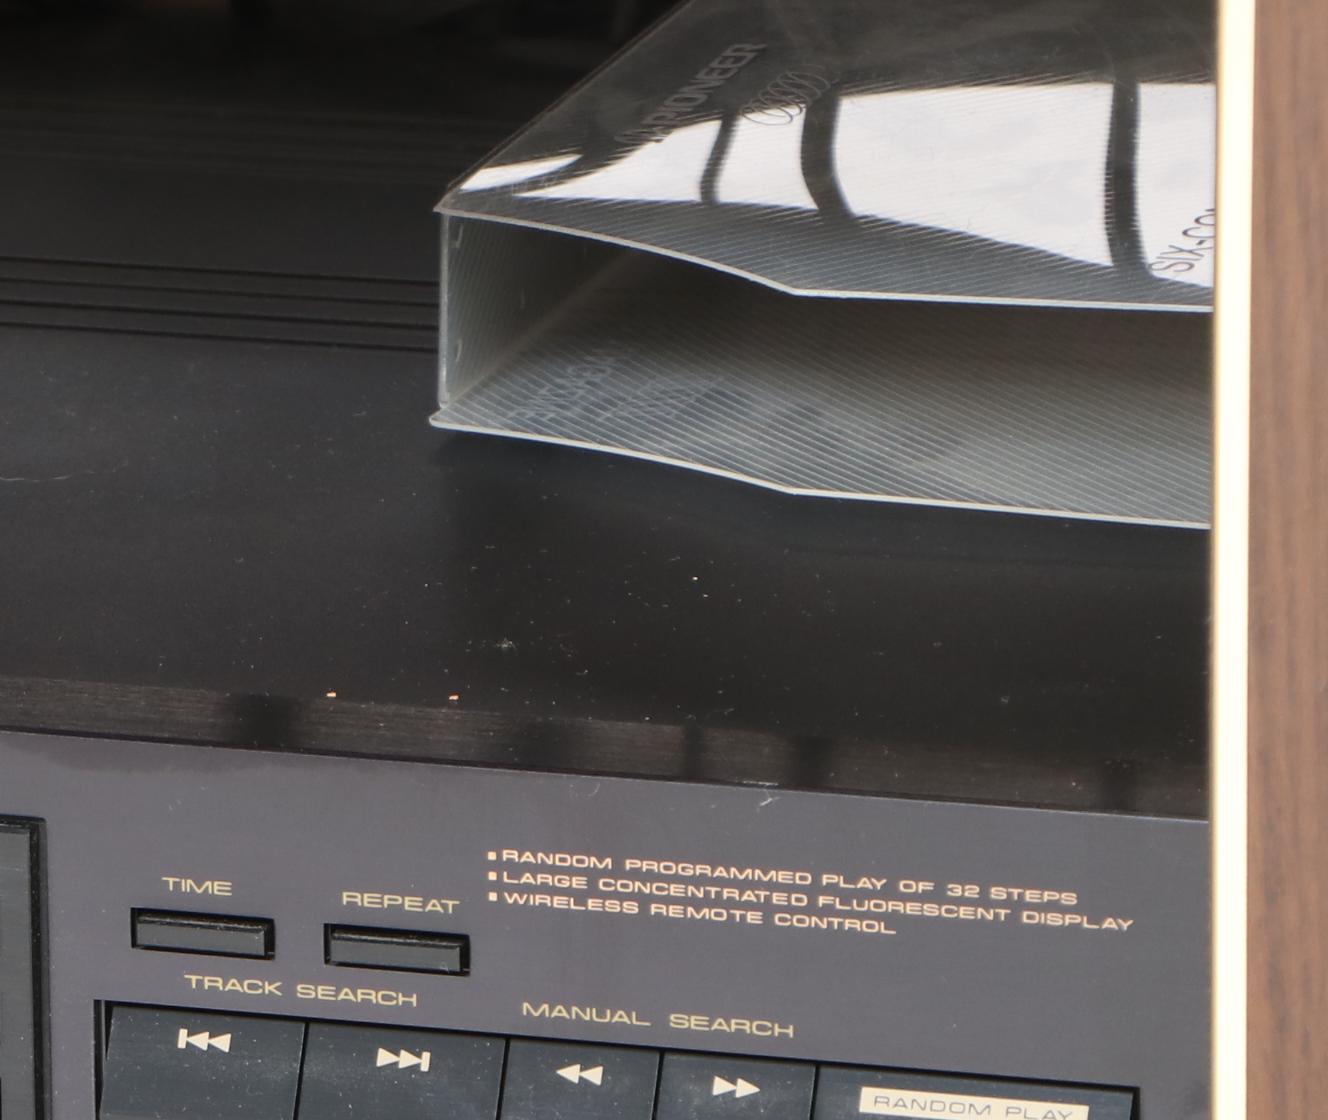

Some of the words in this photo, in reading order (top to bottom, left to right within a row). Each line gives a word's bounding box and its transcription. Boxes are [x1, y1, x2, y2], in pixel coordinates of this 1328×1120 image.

[641, 42, 769, 128] PIONEER
[161, 877, 233, 896] TIME
[502, 849, 612, 870] RANDOM
[625, 858, 812, 886] PROGRAMMED
[821, 874, 887, 890] PLAY
[899, 880, 935, 894] OF
[947, 883, 980, 898] 32
[990, 886, 1078, 905] STEPS
[342, 891, 460, 914] REPEAT
[503, 871, 588, 889] LARGE
[598, 878, 809, 906] CONCENTRATED
[817, 895, 1012, 922] FLUORESCENT
[1022, 910, 1134, 931] DISPLAY
[503, 891, 640, 914] WIRELESS
[650, 903, 763, 924] REMOTE
[774, 913, 897, 935] CONTROL
[183, 974, 282, 996] TRACK
[296, 984, 417, 1007] SEARCH
[522, 1002, 651, 1026] MANUAL
[669, 1013, 794, 1038] SEARCH
[873, 1094, 992, 1117] RANDOM
